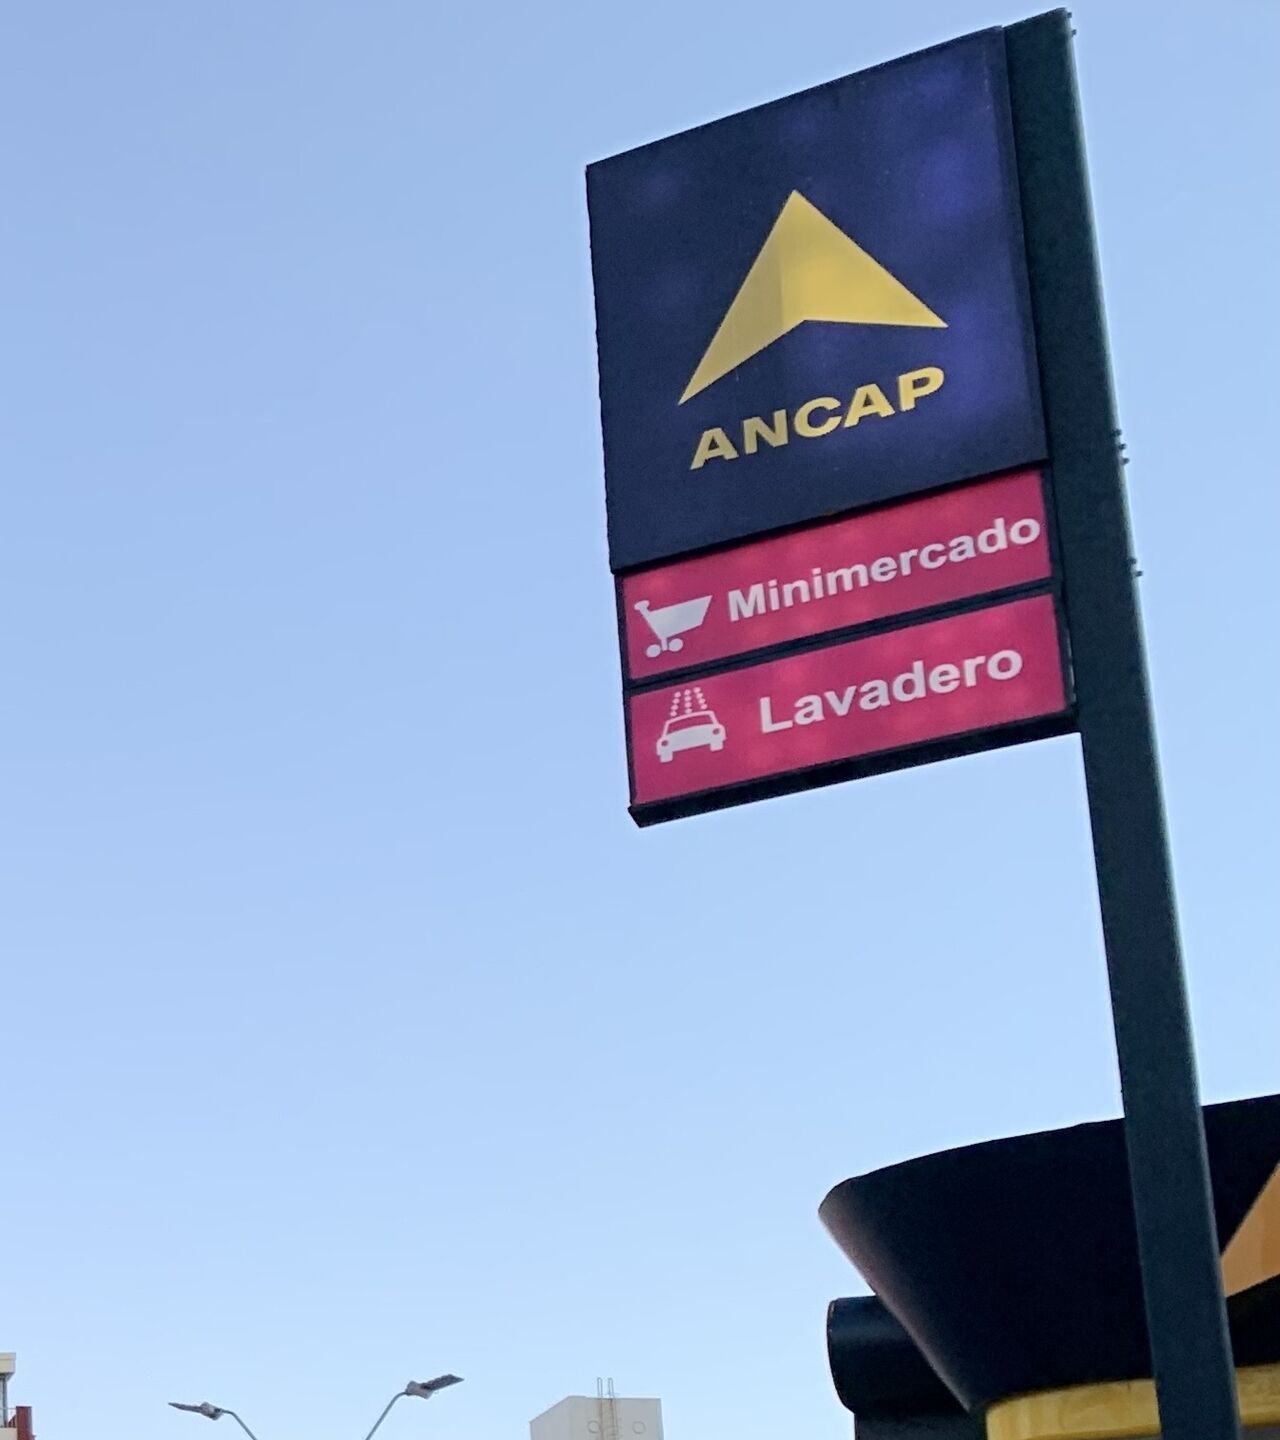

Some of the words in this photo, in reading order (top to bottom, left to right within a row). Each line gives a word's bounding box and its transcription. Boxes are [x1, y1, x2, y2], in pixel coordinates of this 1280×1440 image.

[689, 366, 945, 471] ANCAP
[727, 516, 1042, 623] Minimercado
[758, 649, 1024, 735] Lavadero
